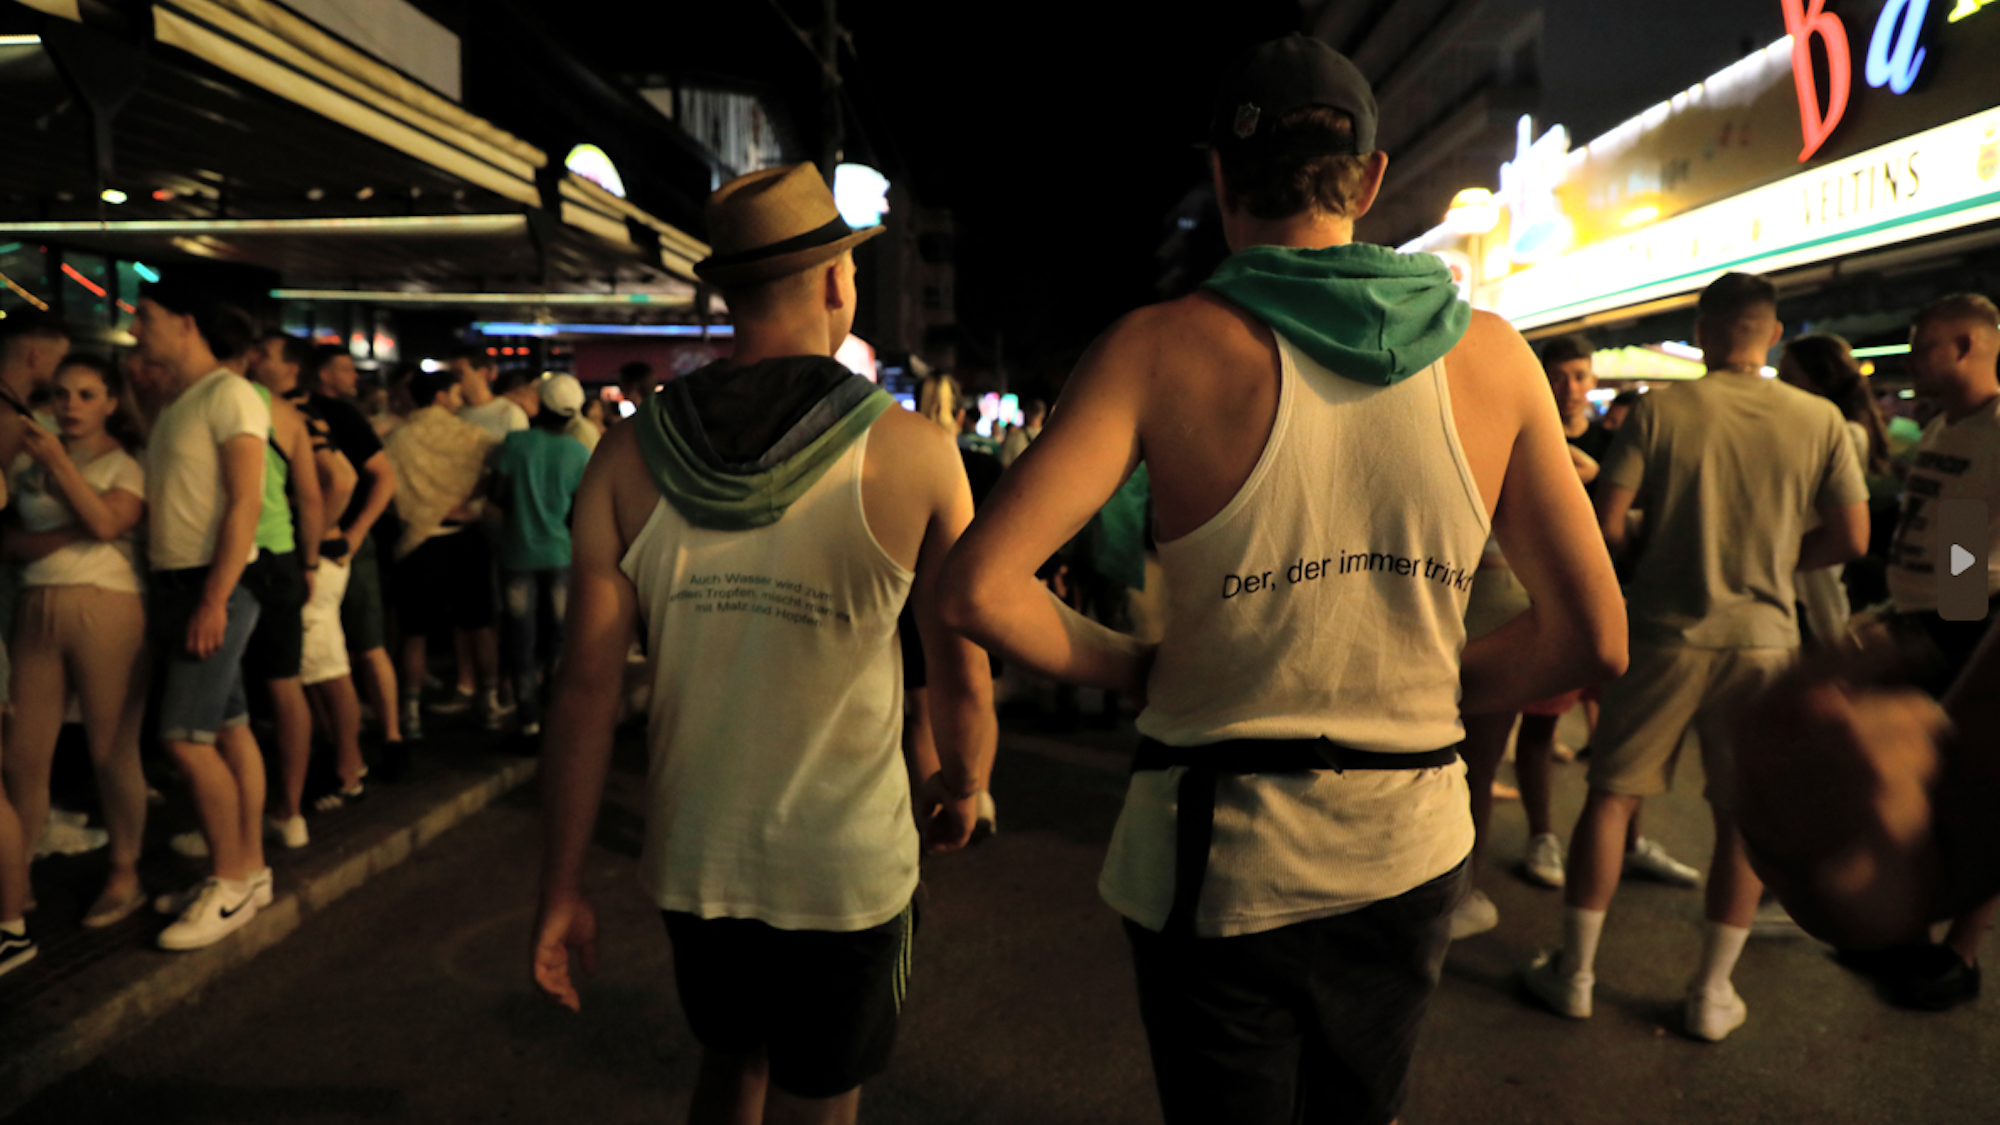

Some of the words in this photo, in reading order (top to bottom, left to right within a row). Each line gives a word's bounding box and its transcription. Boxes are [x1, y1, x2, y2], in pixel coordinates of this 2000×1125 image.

[1782, 0, 1997, 163] Ba
[1802, 151, 1920, 225] VELTINS
[689, 574, 721, 585] Auch
[724, 573, 771, 586] Wasser
[775, 580, 802, 593] wird
[805, 587, 832, 600] zum
[1222, 571, 1276, 599] Der,
[1287, 558, 1331, 584] der
[1339, 550, 1420, 578] immer
[695, 603, 713, 613] mit
[717, 601, 748, 613] Malz
[751, 604, 771, 616] und
[761, 592, 801, 608] mischt
